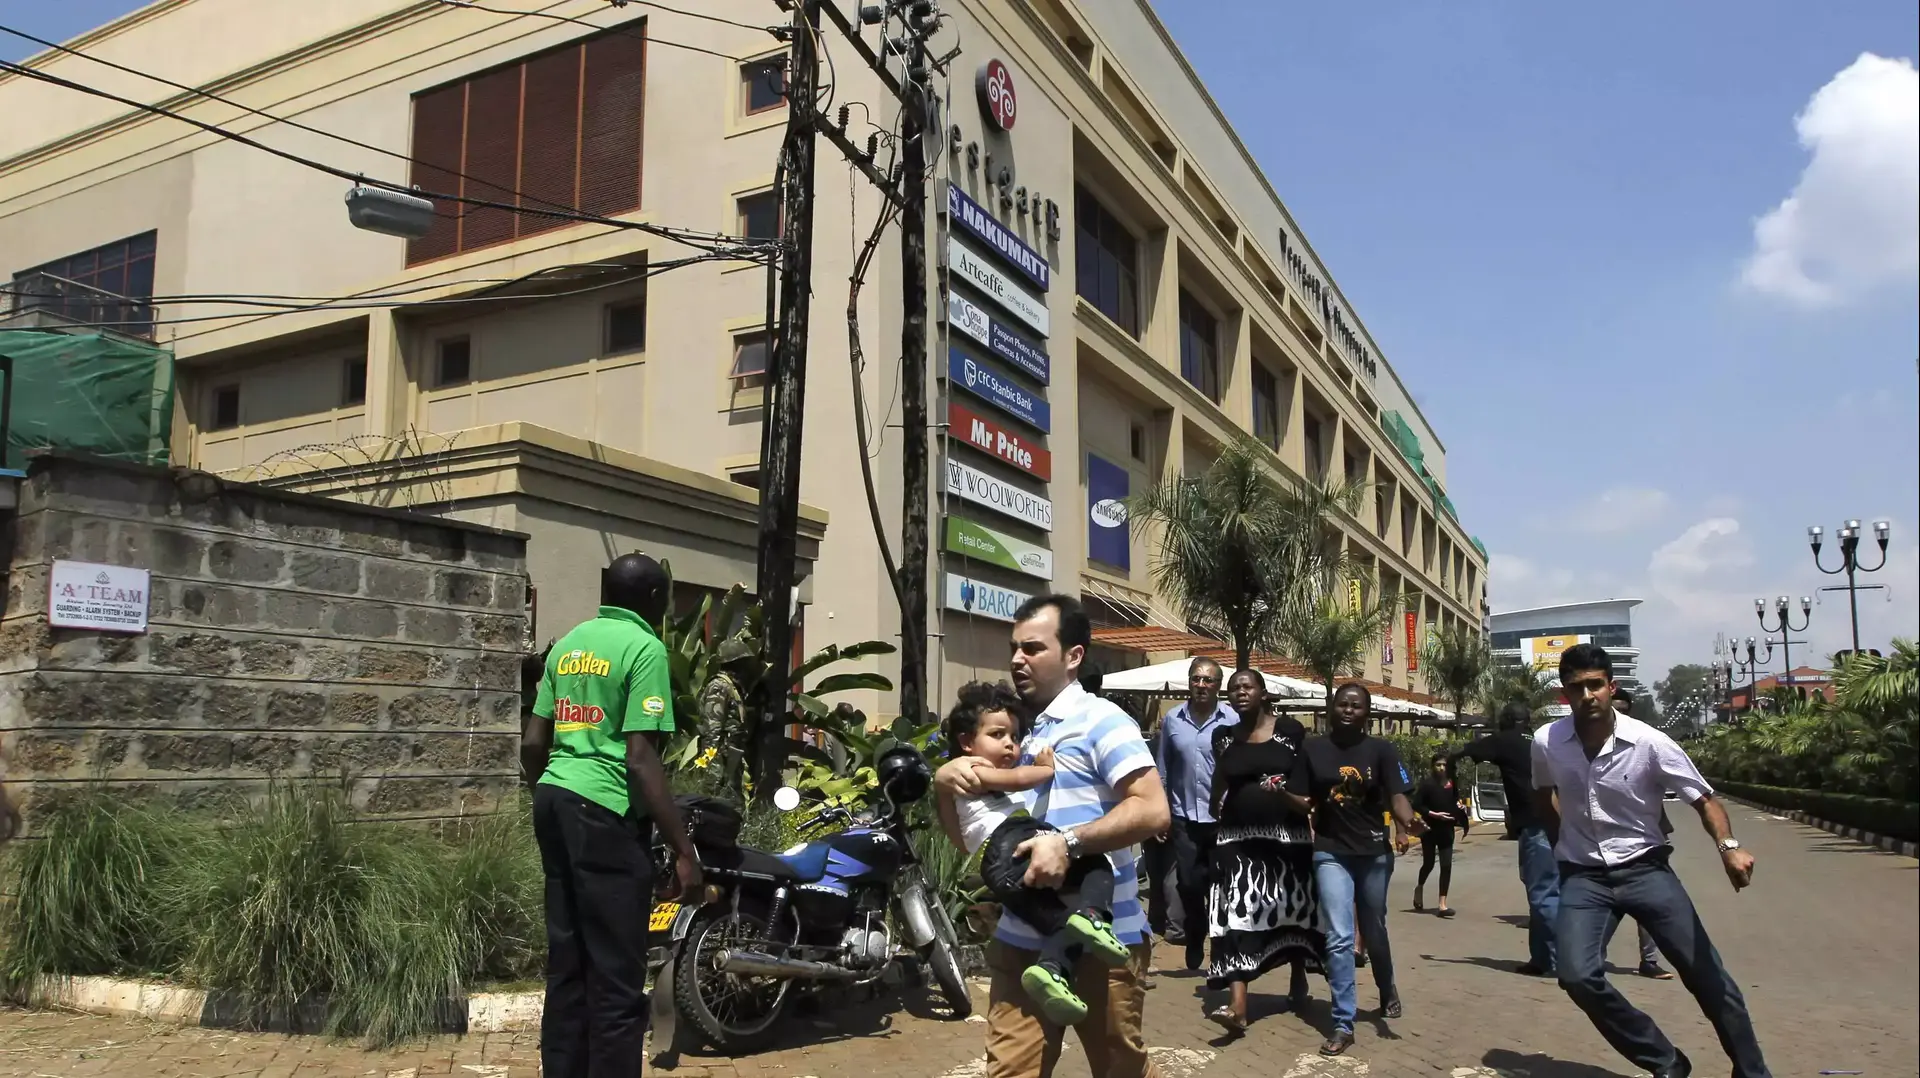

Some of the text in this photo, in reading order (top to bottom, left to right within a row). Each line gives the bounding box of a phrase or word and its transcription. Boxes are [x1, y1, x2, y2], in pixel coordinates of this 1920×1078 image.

[962, 199, 1048, 282] NAKUMATT
[963, 304, 981, 328] Sona
[993, 323, 1014, 345] Passport
[1014, 337, 1031, 358] Photos,
[1032, 349, 1046, 367] Prints,
[993, 338, 1046, 378] Cameras & Accessories
[991, 377, 1016, 402] Stanbic
[1016, 392, 1033, 412] Bank
[970, 418, 1032, 470] Mr Price
[965, 470, 1051, 525] WOOLWORTHS
[958, 531, 996, 554] Retail Center
[56, 604, 142, 618] GUARDING ALARM SYSTEM BACKUP
[87, 585, 143, 604] TEAM
[978, 585, 1026, 618] BARCL
[557, 650, 610, 677] Golden
[873, 834, 888, 843] TVS
